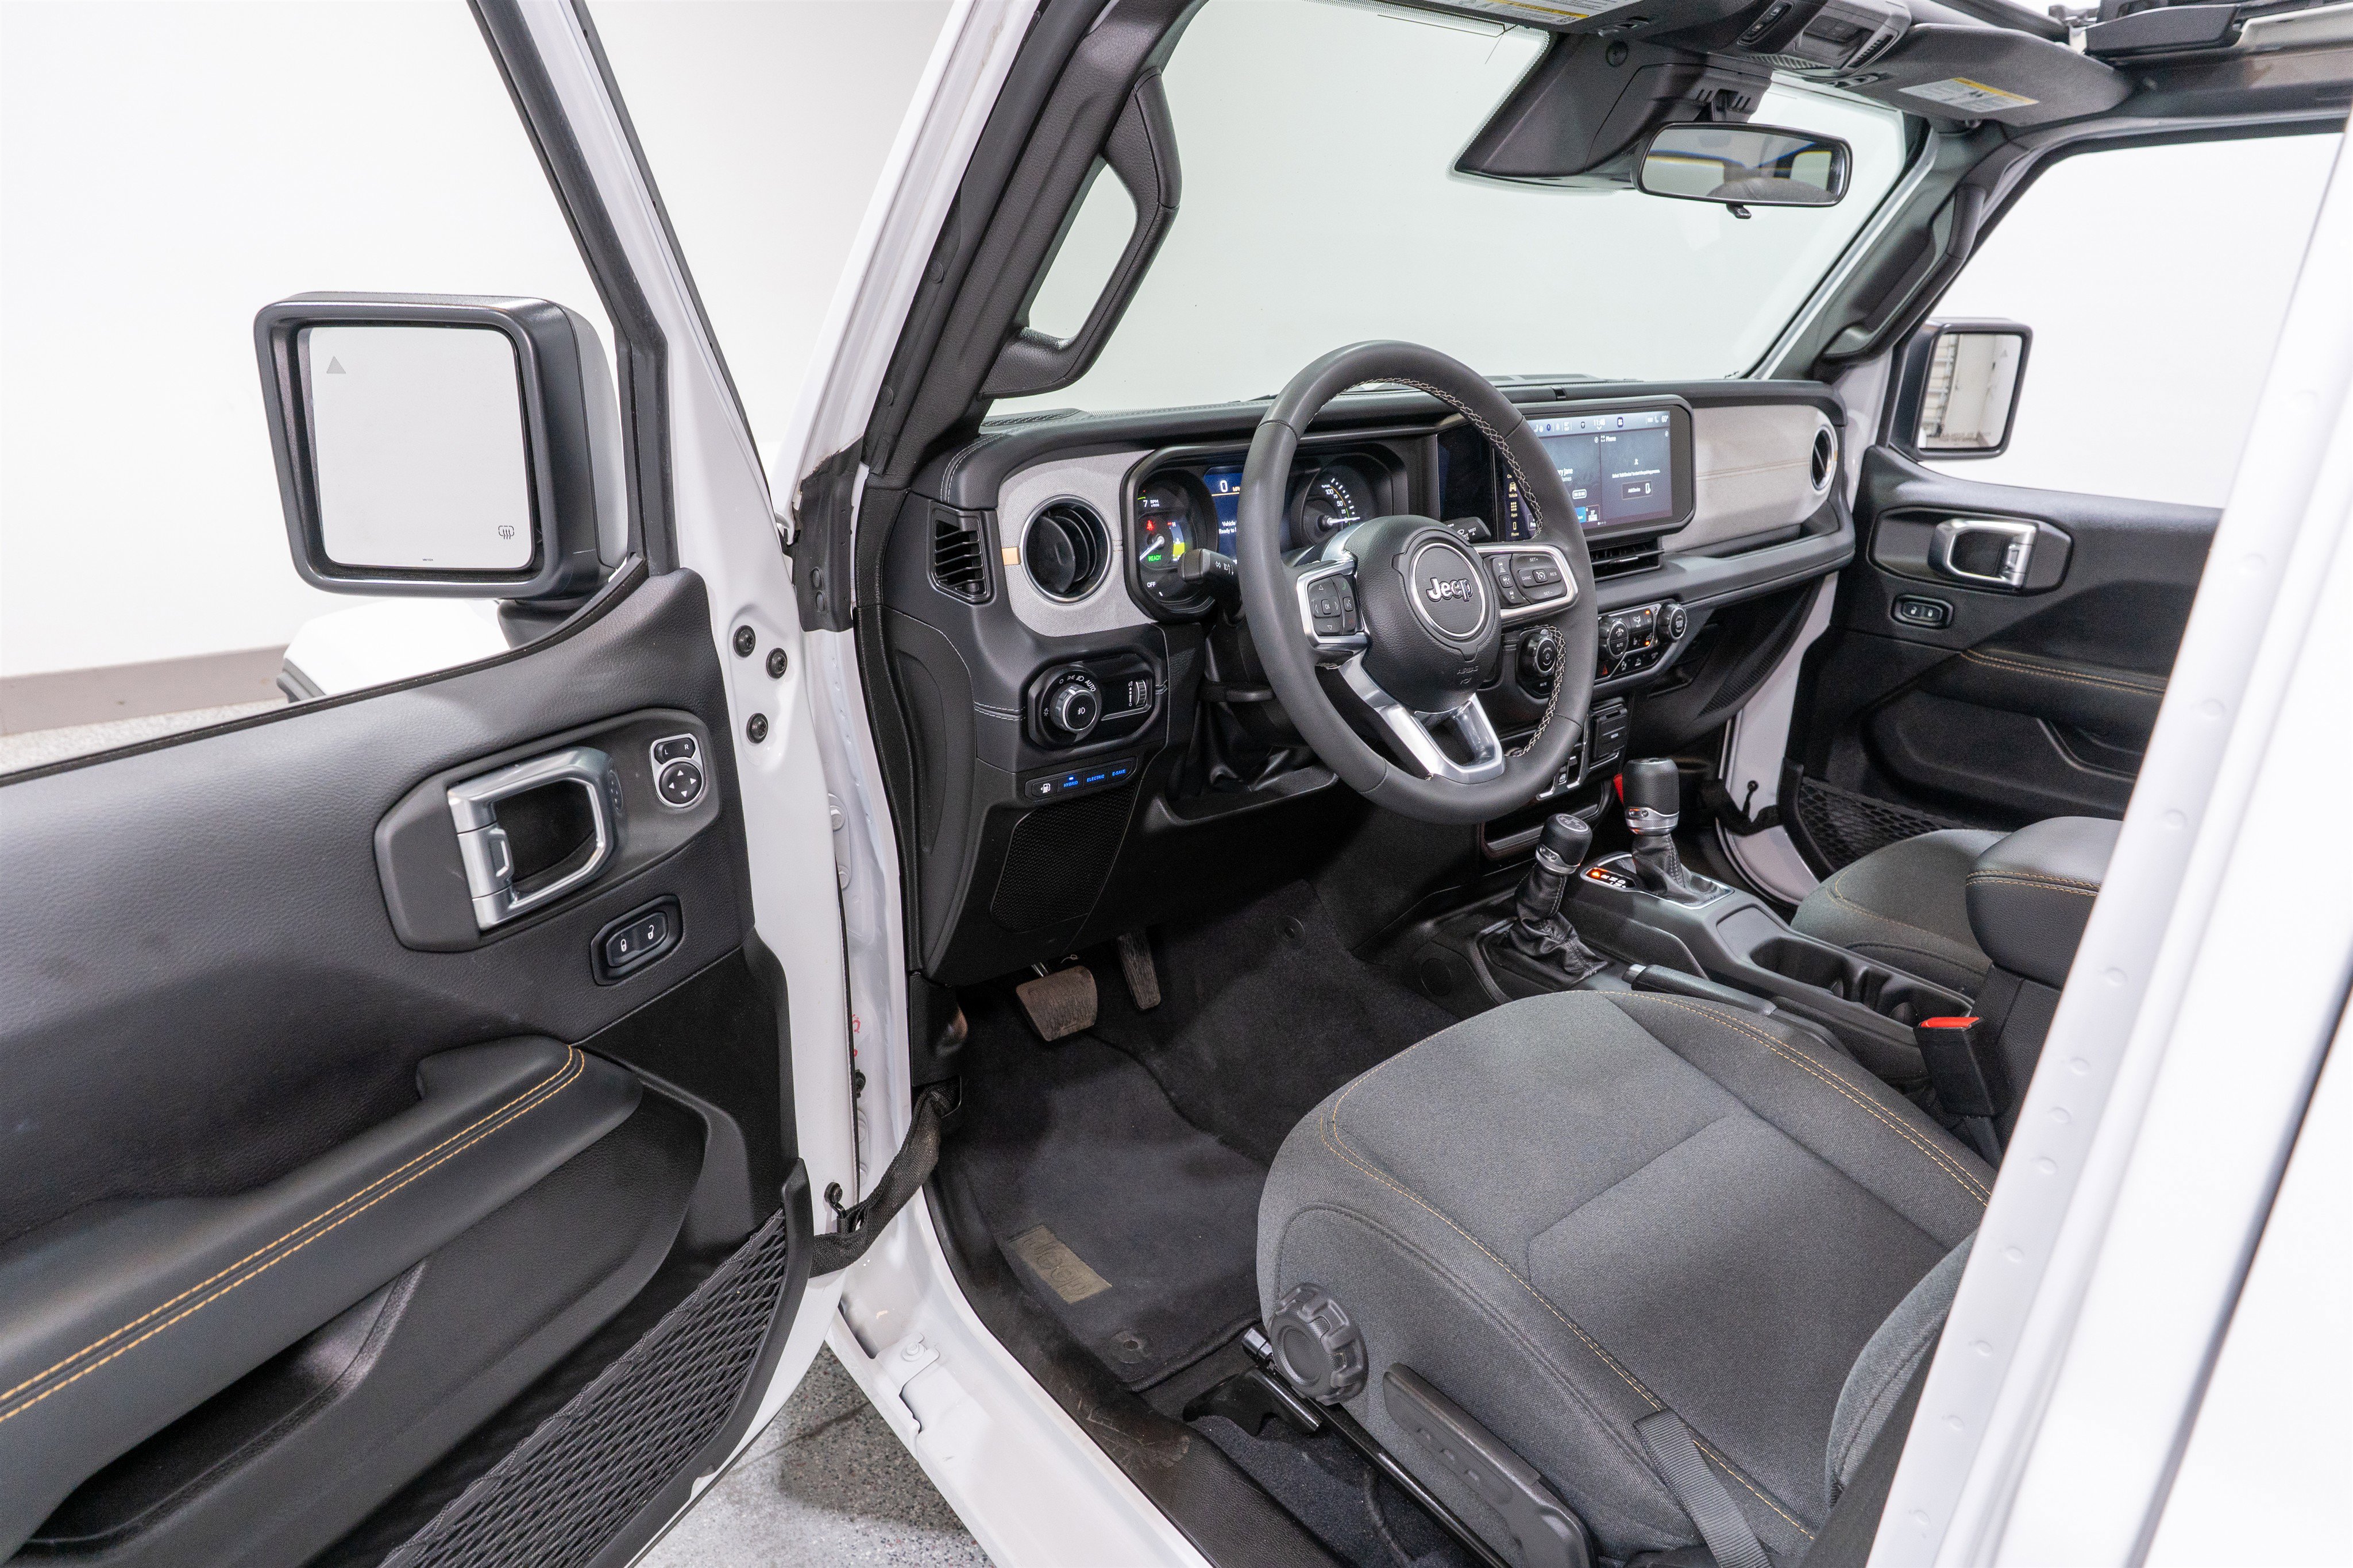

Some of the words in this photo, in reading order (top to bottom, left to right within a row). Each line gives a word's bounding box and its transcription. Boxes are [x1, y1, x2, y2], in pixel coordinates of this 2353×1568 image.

[1220, 480, 1228, 493] 0
[1426, 577, 1473, 601] Jeep
[1085, 679, 1096, 692] AUTO
[1086, 774, 1105, 782] ELECTRIC
